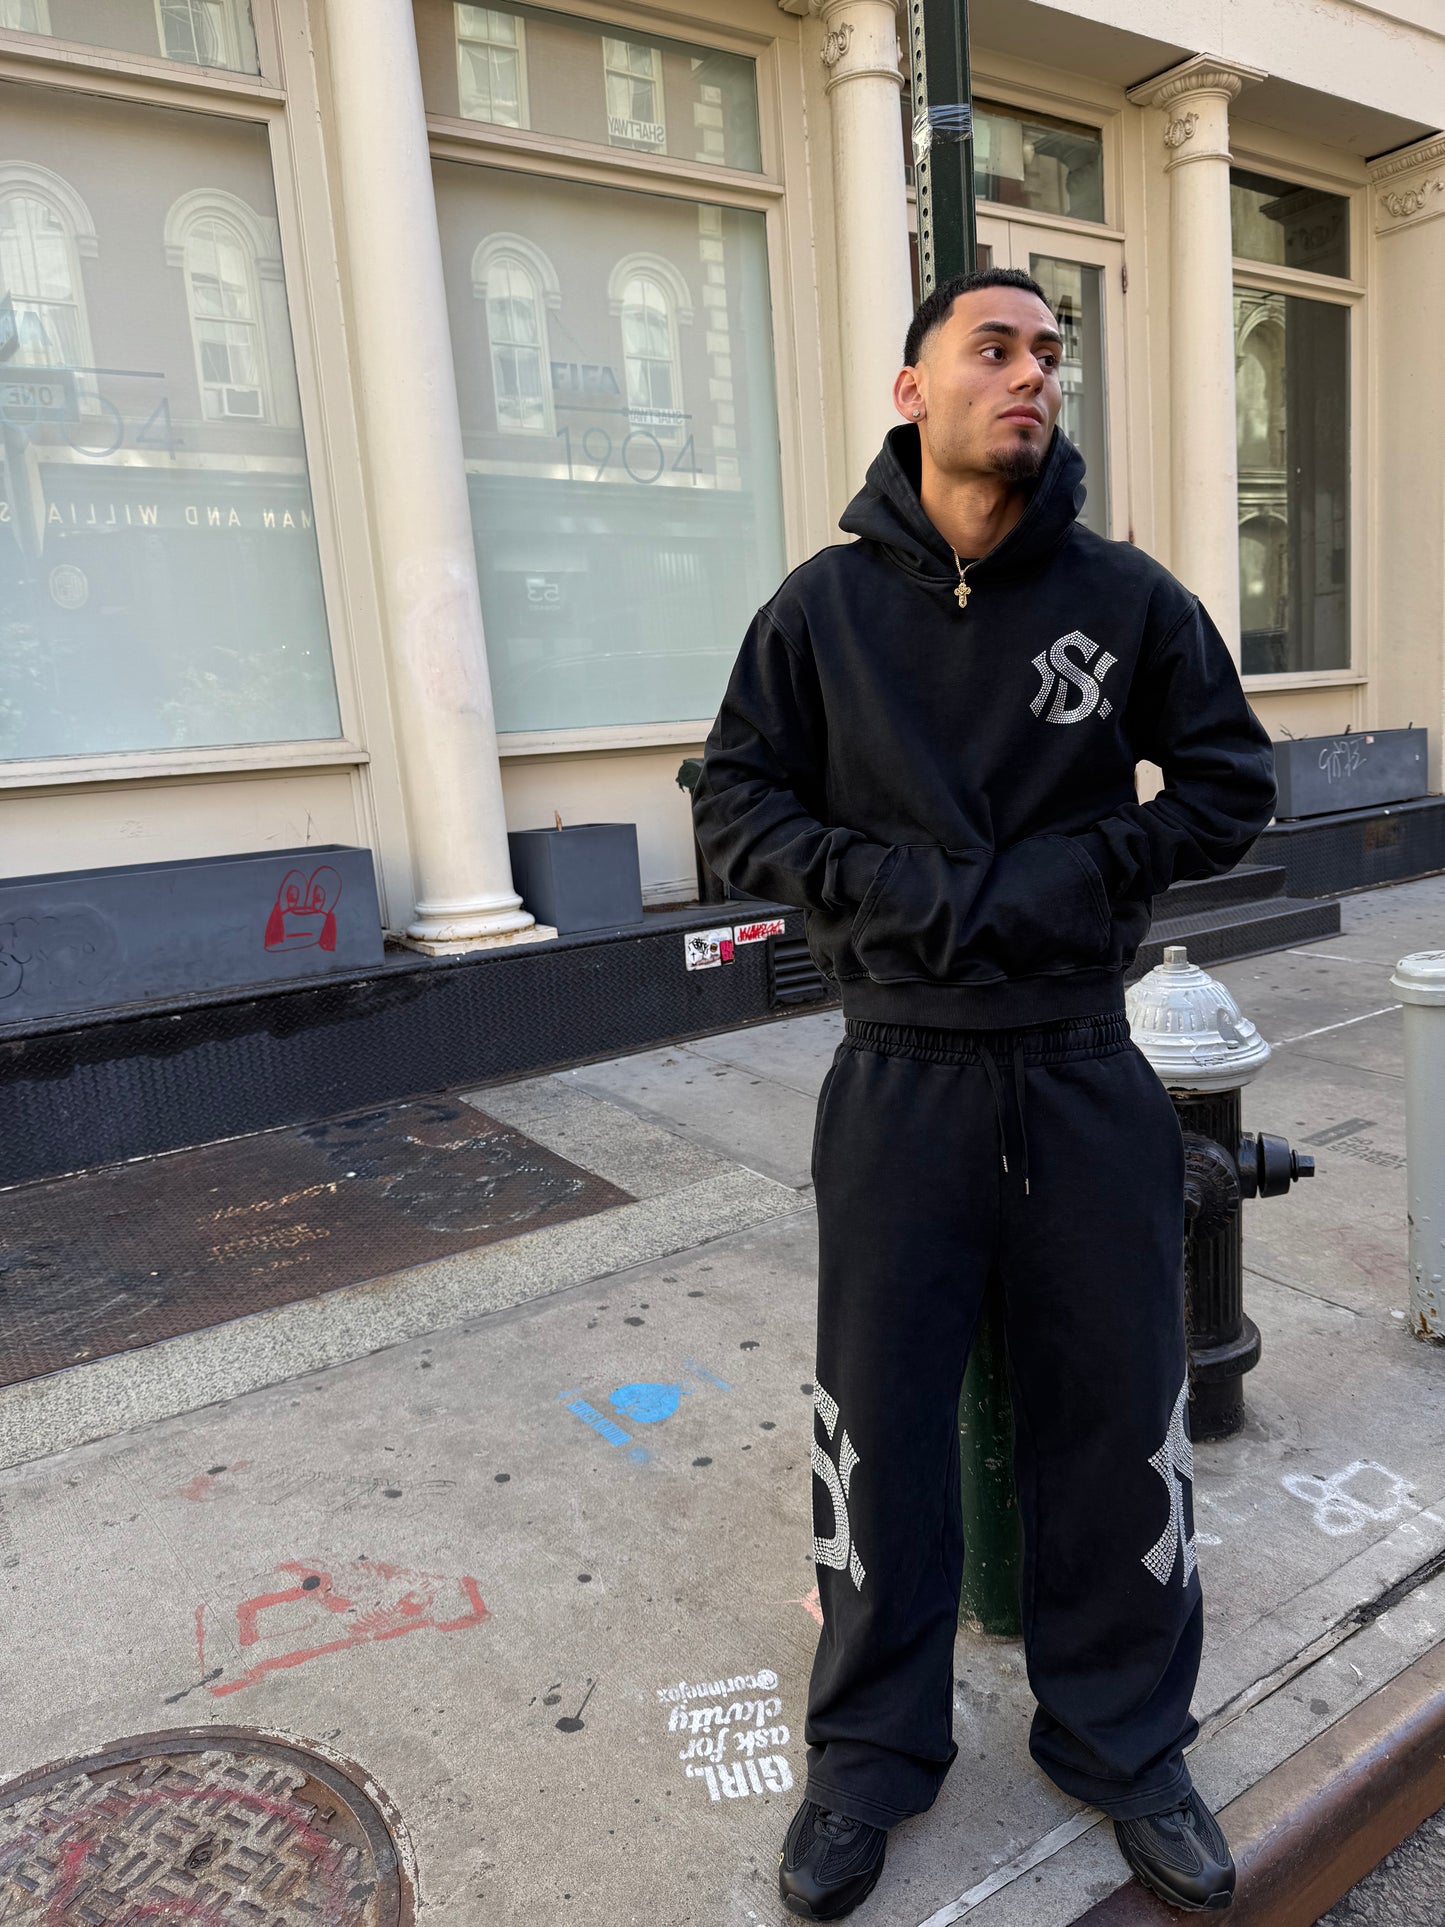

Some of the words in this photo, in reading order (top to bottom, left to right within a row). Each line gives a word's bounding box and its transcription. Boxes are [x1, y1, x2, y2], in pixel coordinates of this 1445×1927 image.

[550, 361, 620, 394] FIFA
[556, 426, 703, 486] 1904
[668, 1697, 782, 1734] clarity
[679, 1727, 729, 1762] for
[733, 1725, 790, 1756] ask
[685, 1755, 793, 1802] GIRL,
